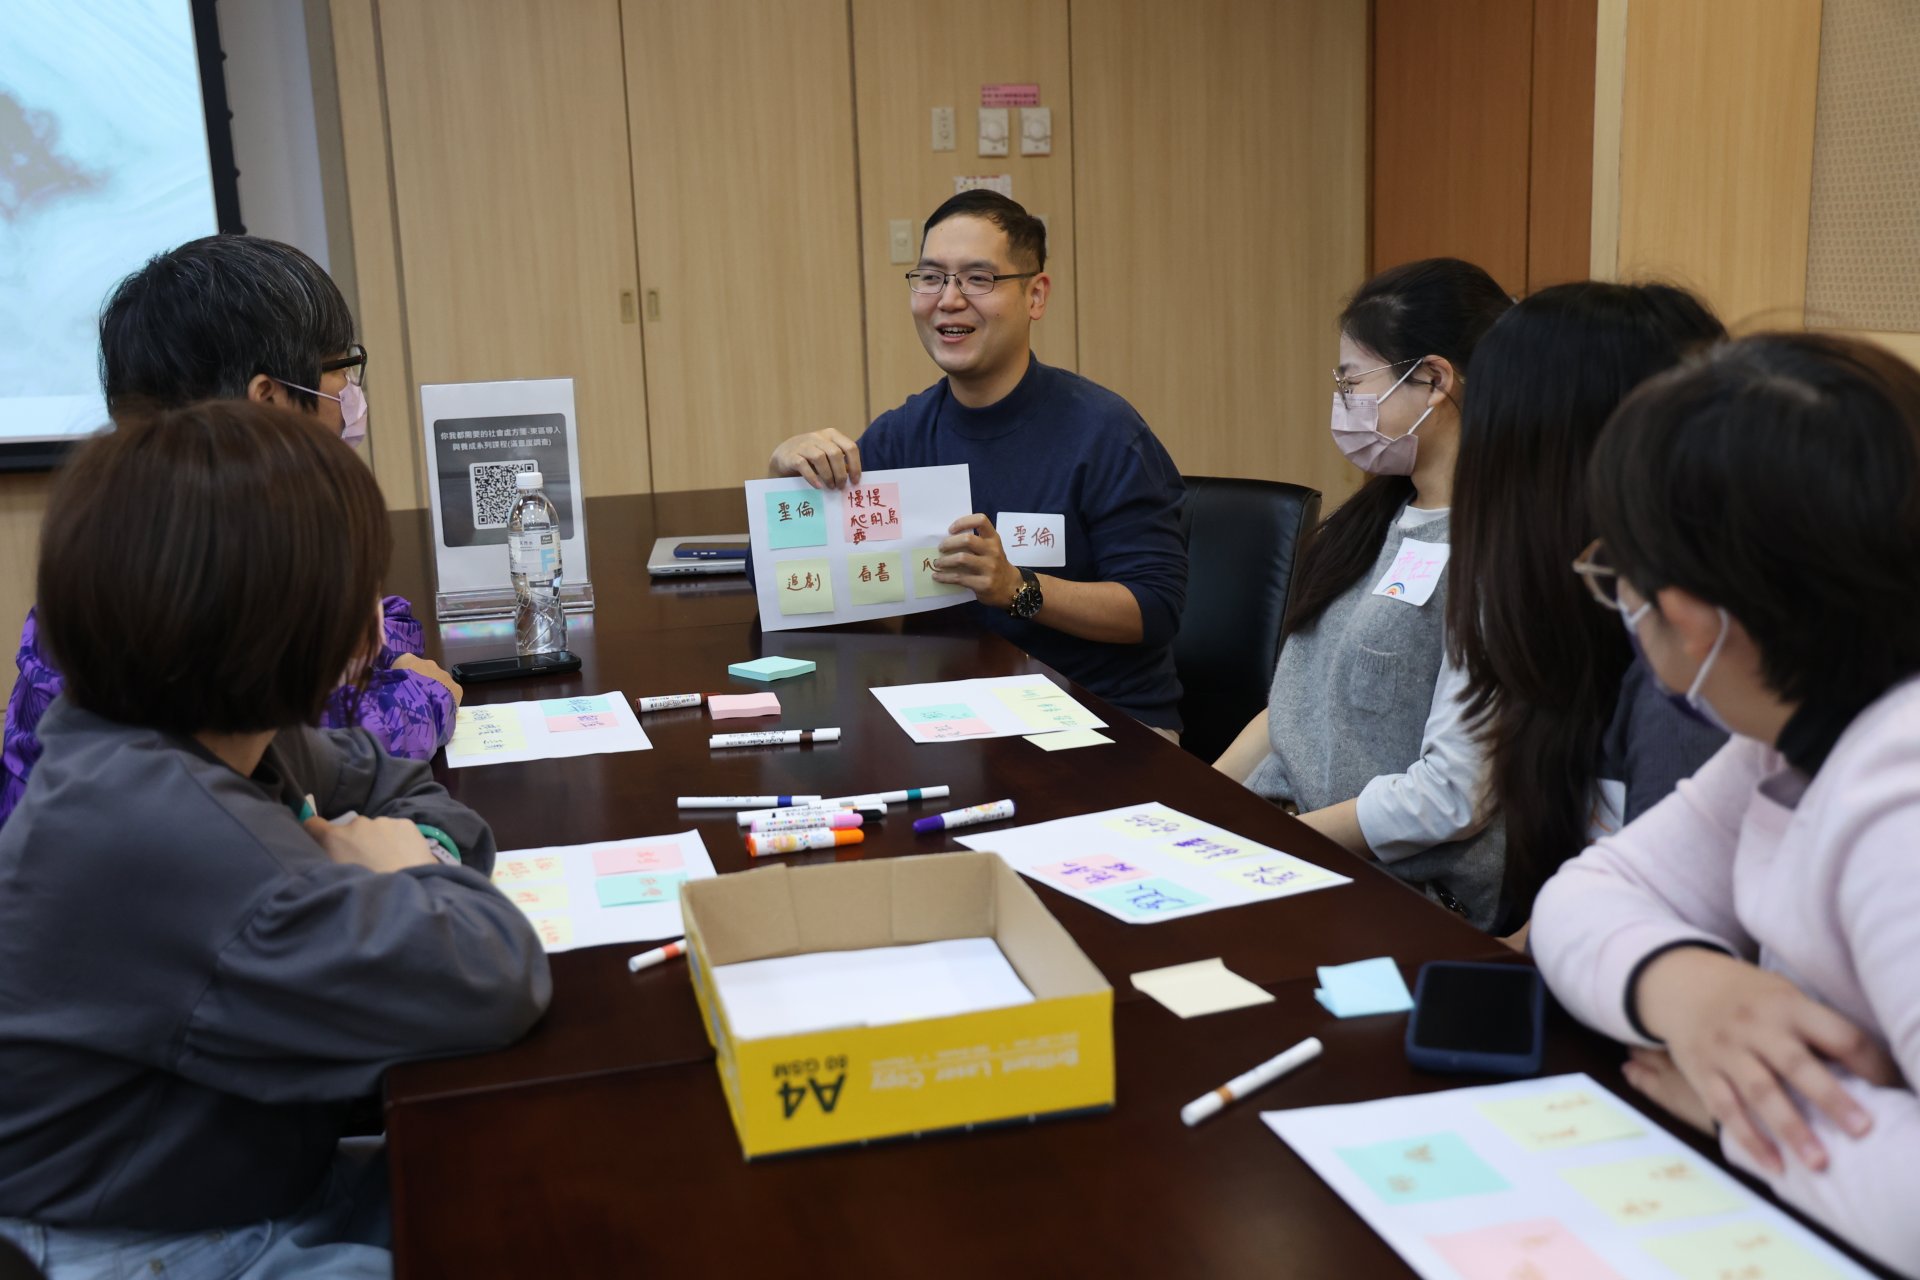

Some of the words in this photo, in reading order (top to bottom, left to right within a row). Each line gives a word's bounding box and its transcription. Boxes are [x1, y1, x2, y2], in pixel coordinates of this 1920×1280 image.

[848, 488, 887, 508] 慢慢
[778, 501, 815, 522] 聖倫
[1011, 525, 1055, 547] 聖倫
[786, 573, 821, 591] 追劇
[858, 562, 889, 583] 看書
[777, 1073, 847, 1119] A4
